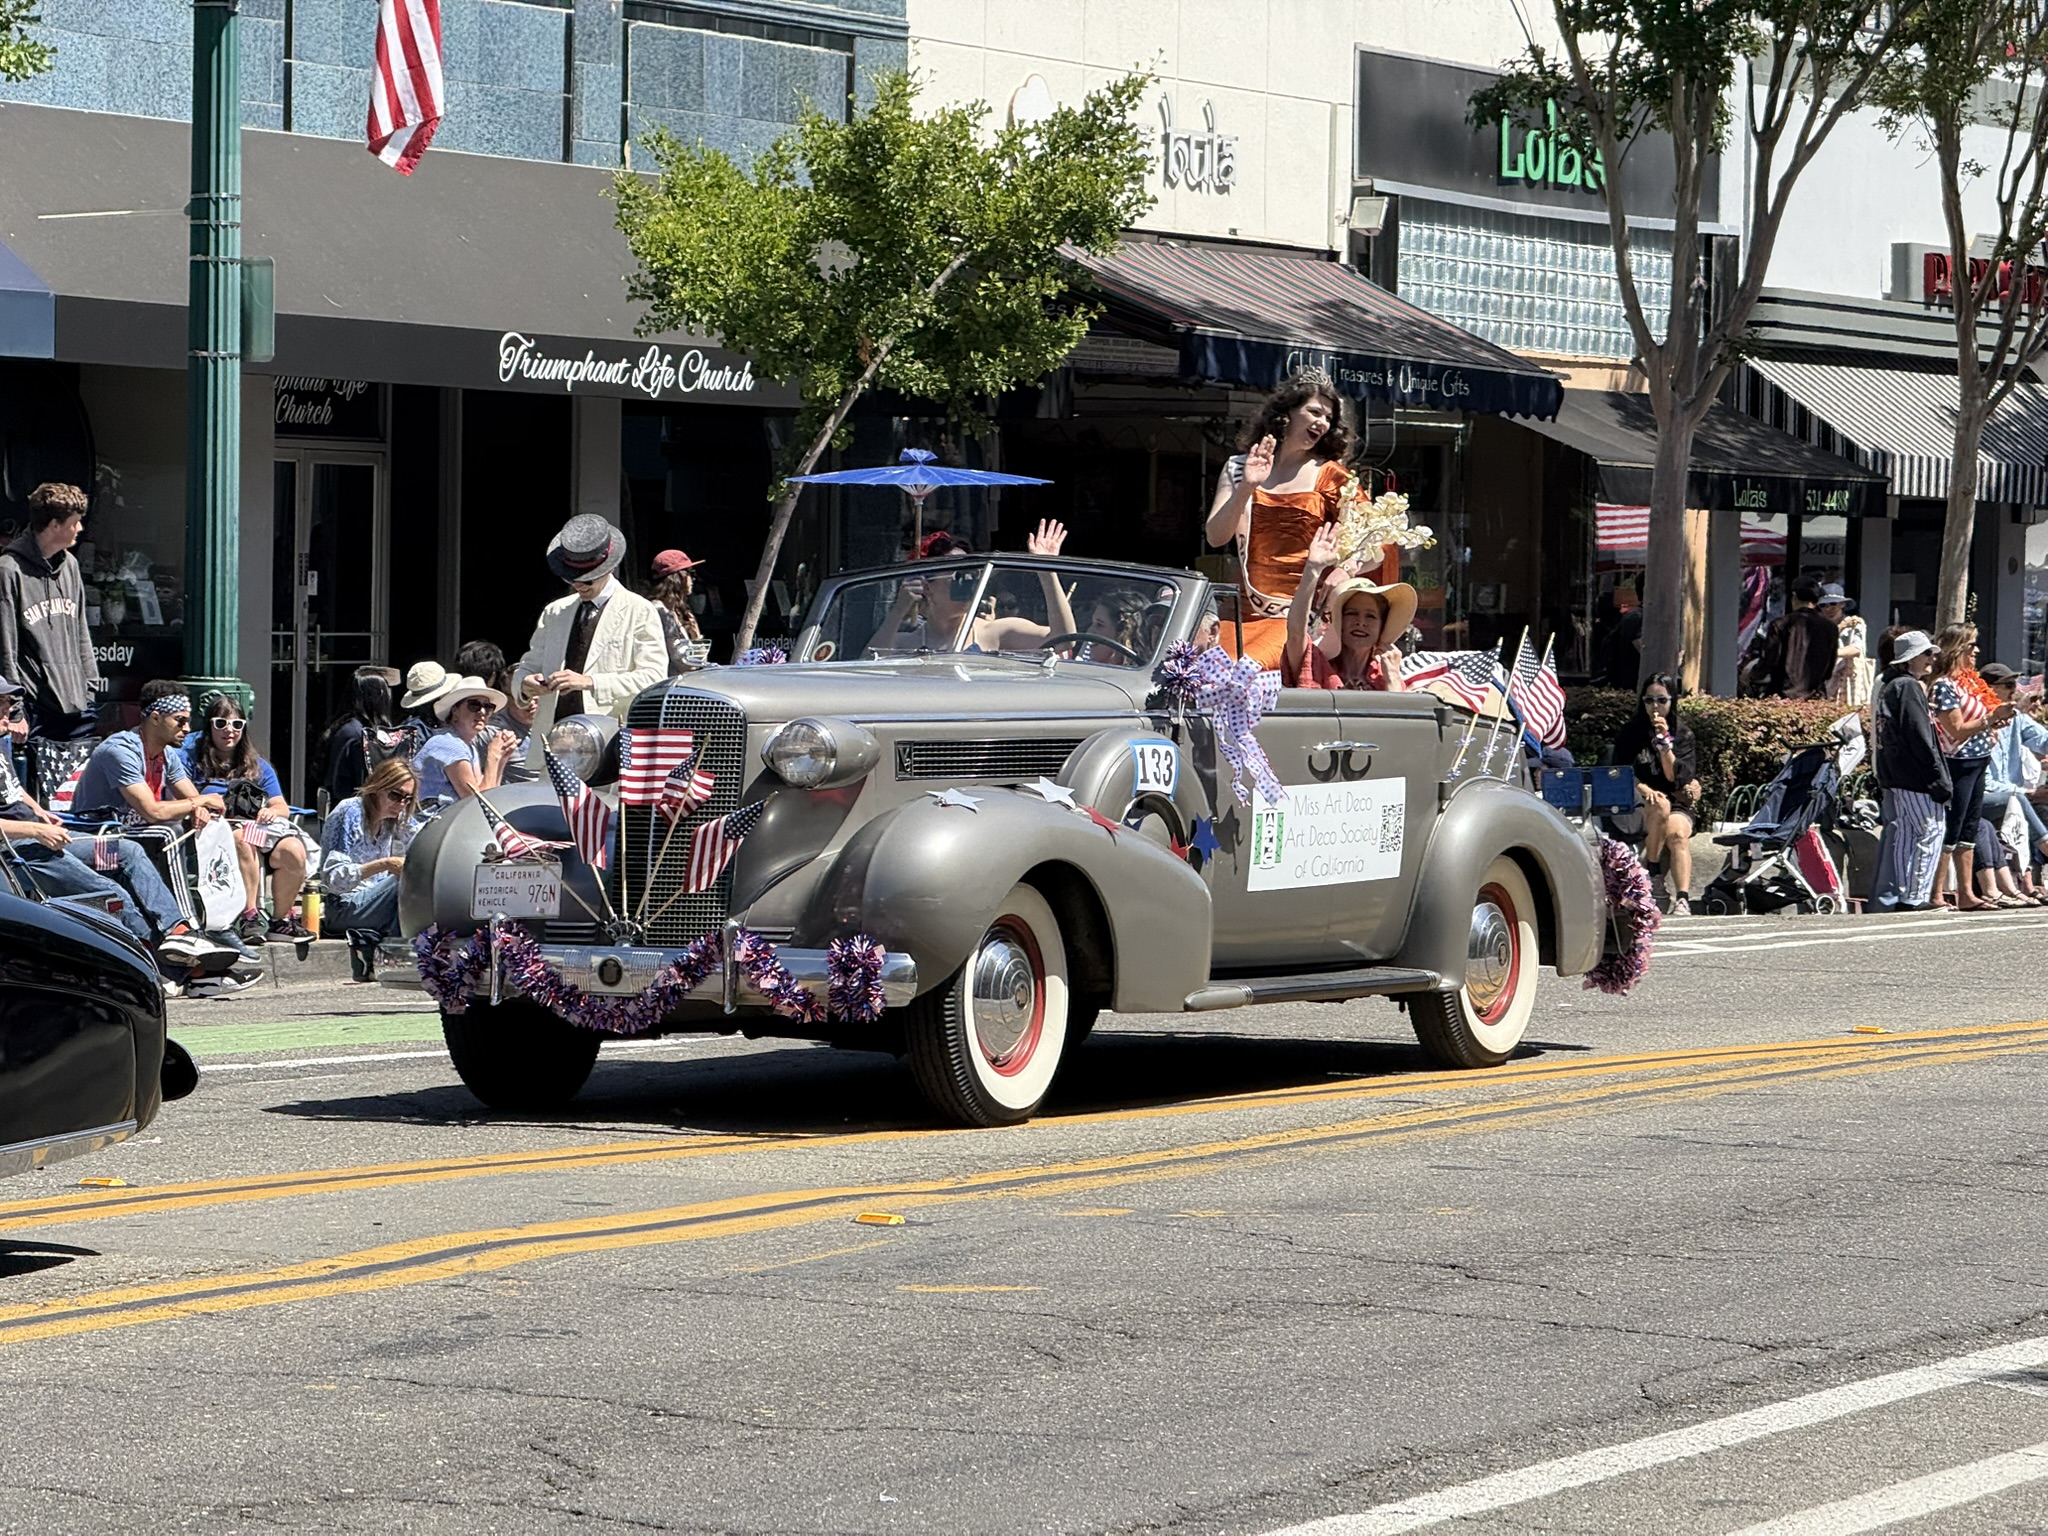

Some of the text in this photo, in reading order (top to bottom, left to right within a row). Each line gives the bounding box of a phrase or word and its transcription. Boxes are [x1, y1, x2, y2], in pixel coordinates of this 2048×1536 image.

[499, 331, 755, 398] Triumphant Life Church
[1329, 355, 1383, 386] Treasures
[1400, 365, 1439, 401] Unique
[275, 394, 334, 425] Church
[1806, 489, 1849, 511] 521-4488
[23, 604, 43, 625] SAN
[1139, 747, 1173, 787] 133
[1294, 791, 1373, 816] Miss Art Deco
[1284, 822, 1379, 848] Art Deco Society
[495, 870, 541, 880] CALIFORNIA
[1294, 855, 1365, 879] of California
[477, 898, 507, 906] VEHICLE
[478, 884, 556, 903] HISTORICAL 976N
